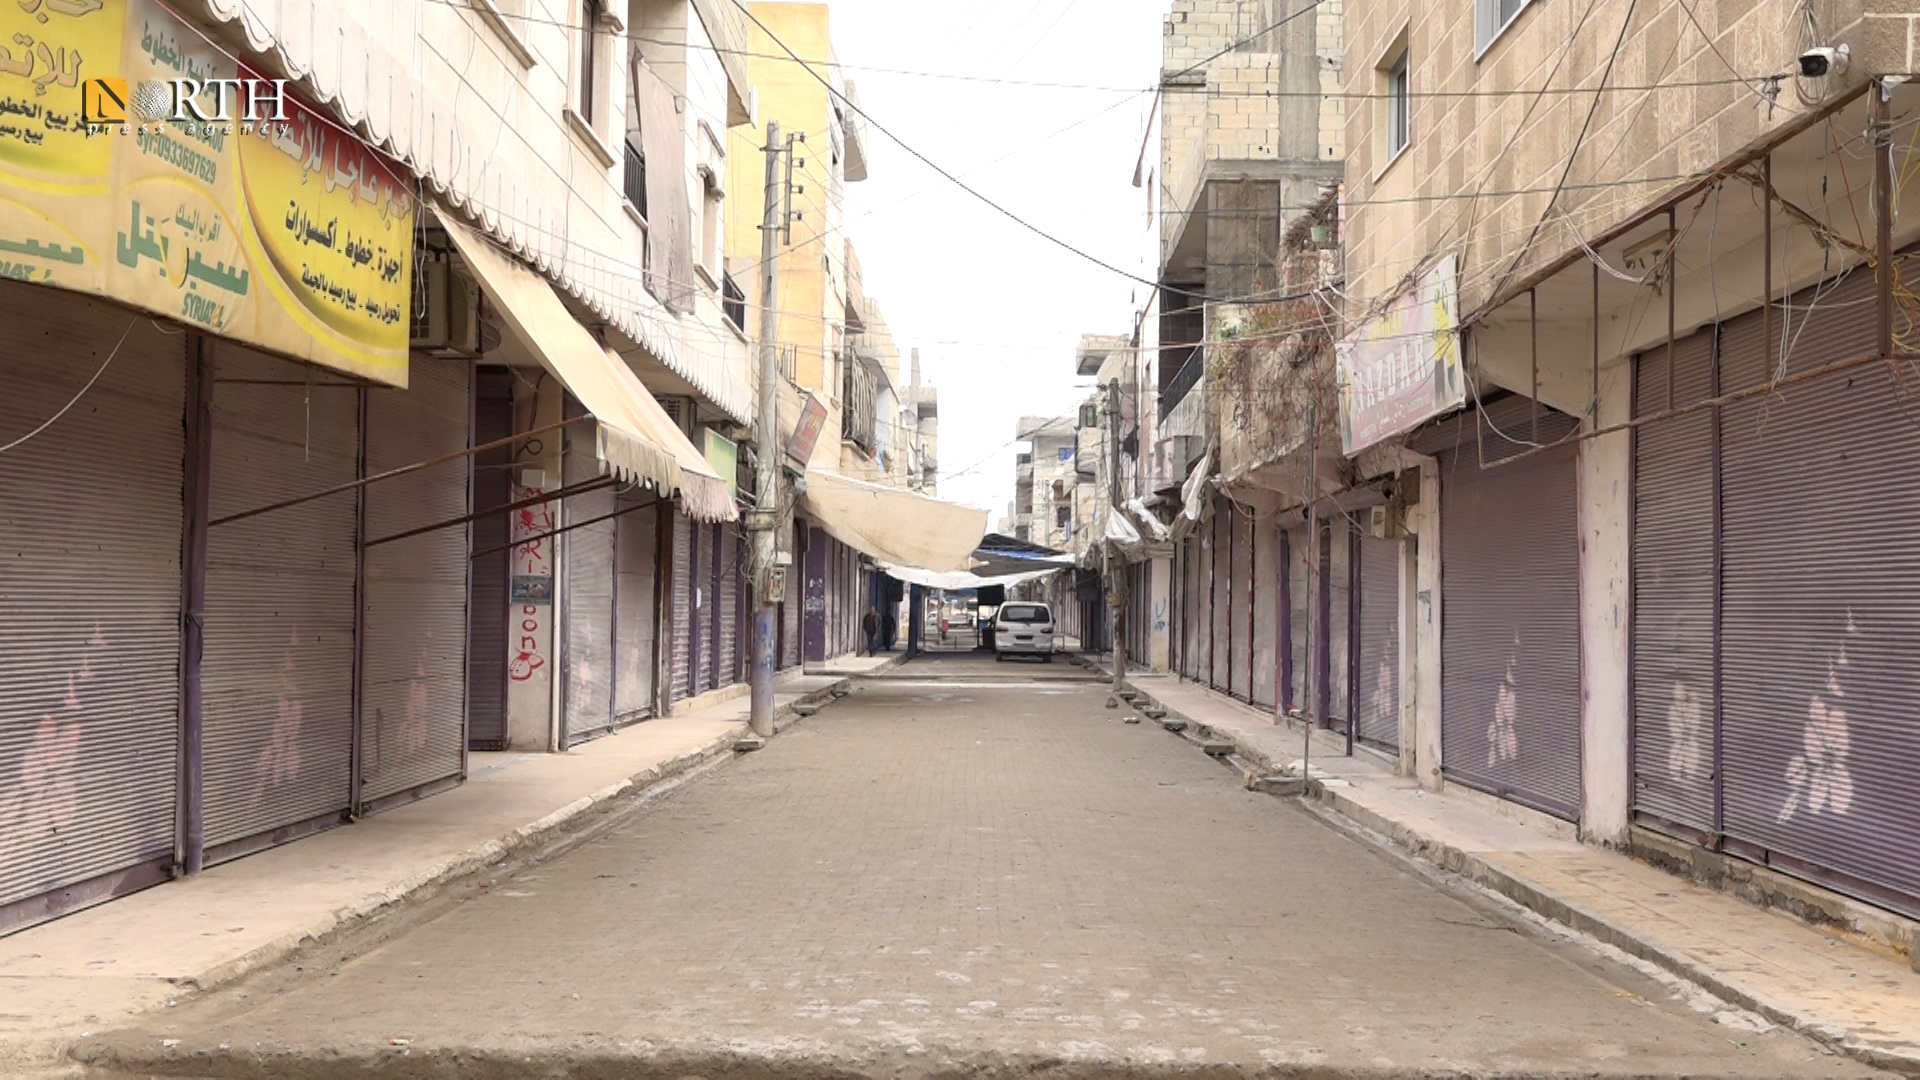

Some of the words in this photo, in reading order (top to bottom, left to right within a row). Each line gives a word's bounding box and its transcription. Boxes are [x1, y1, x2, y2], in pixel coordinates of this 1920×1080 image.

[141, 20, 186, 72] الخطوط
[24, 128, 44, 146] بيع
[45, 110, 69, 132] بيع
[325, 139, 379, 204] عاجل
[345, 229, 373, 269] خطوط
